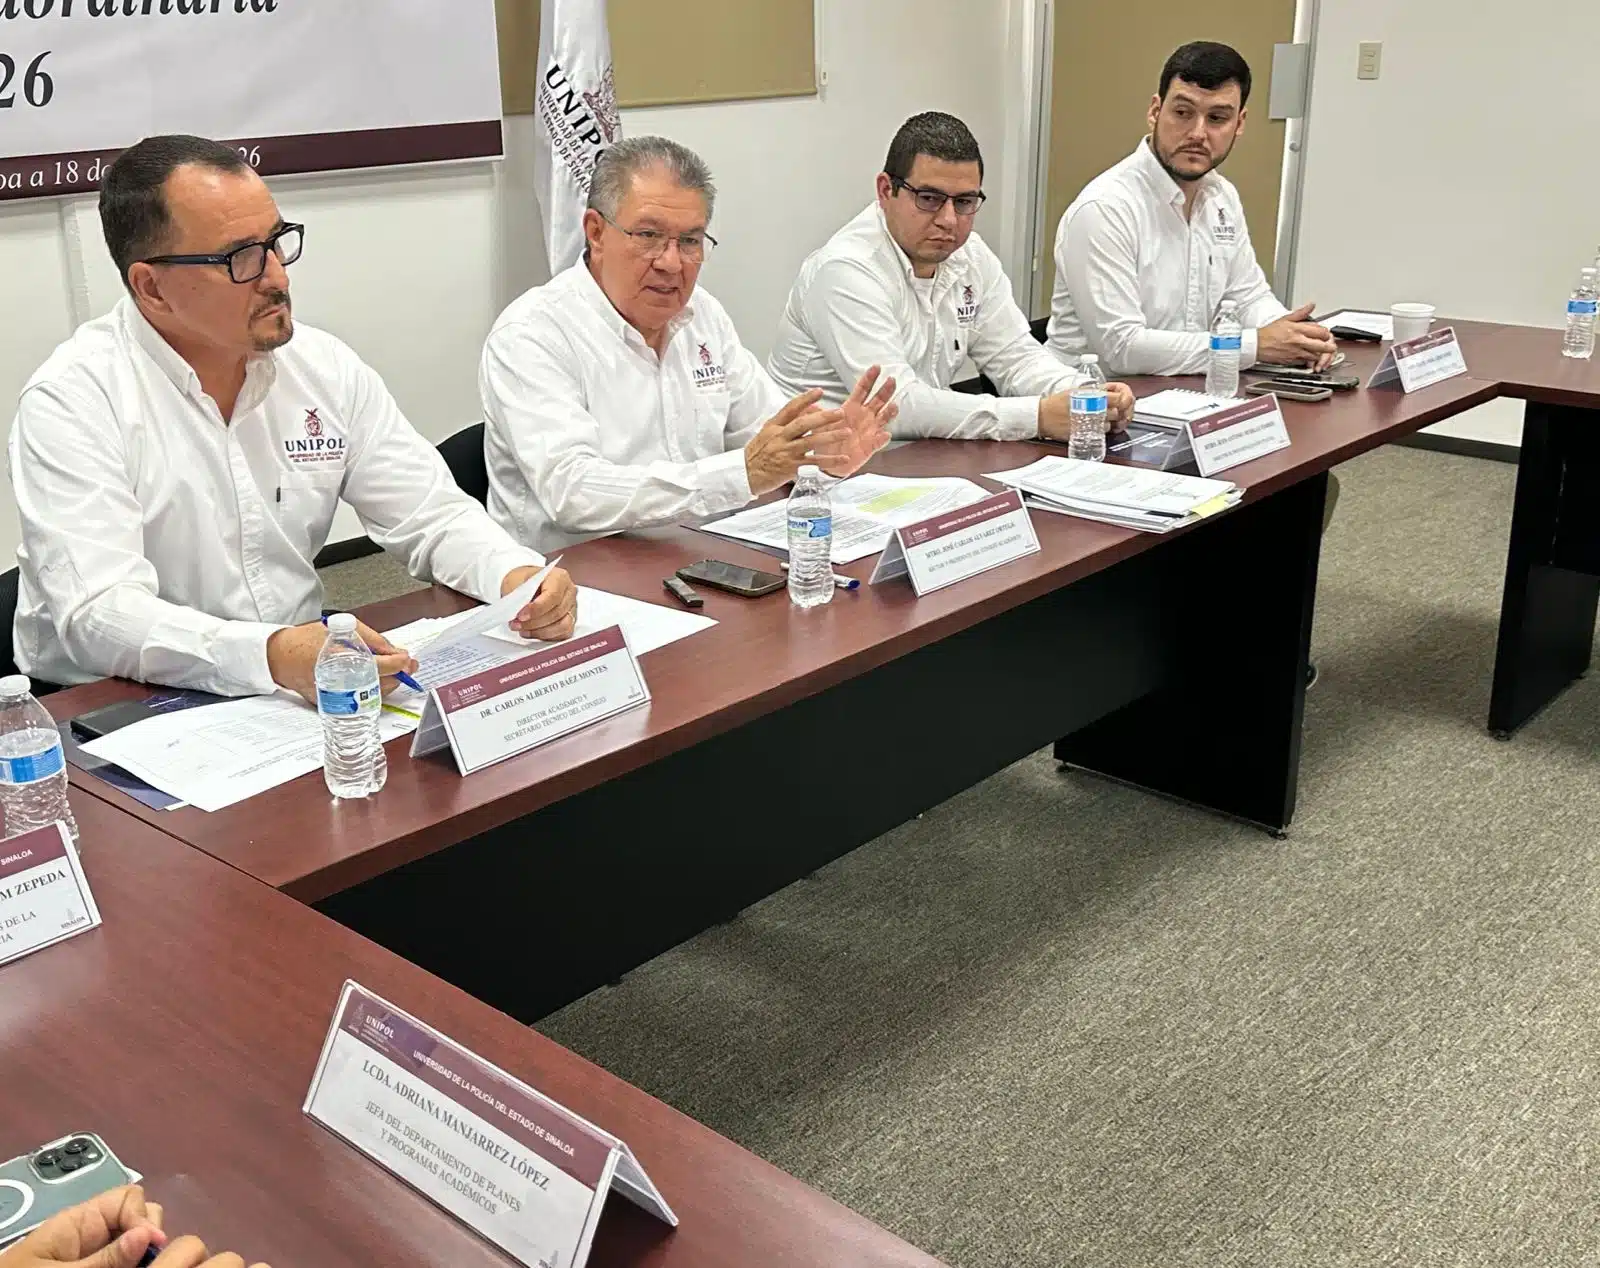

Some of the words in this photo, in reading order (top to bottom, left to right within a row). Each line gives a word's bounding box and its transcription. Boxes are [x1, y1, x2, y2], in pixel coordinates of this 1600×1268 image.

[540, 80, 572, 139] UNIVERSIDAD
[569, 138, 582, 151] DE
[543, 111, 563, 147] ESTADO
[559, 149, 572, 161] DE
[30, 170, 44, 187] a
[54, 160, 79, 185] 18
[284, 438, 346, 452] UNIPOL
[458, 684, 483, 696] UNIPOL
[495, 697, 525, 713] CARLOS
[525, 683, 559, 701] ALBERTO
[579, 664, 609, 681] MONTES
[504, 723, 542, 742] SECRETARIO
[568, 707, 582, 717] DEL
[516, 710, 547, 727] DIRECTOR
[0, 849, 33, 866] SINALOA
[14, 868, 67, 896] ZEPEDA
[5, 914, 21, 928] DE
[21, 910, 37, 922] LA
[365, 1015, 395, 1038] UNIPOL
[413, 1050, 453, 1079] UNIVERSIDAD
[452, 1073, 462, 1085] DE
[461, 1079, 470, 1091] LA
[470, 1085, 494, 1106] POLICÍA
[494, 1100, 508, 1115] DEL
[508, 1109, 535, 1131] ESTADO
[534, 1127, 545, 1138] DE
[545, 1132, 575, 1157] SINALOA
[362, 1059, 392, 1089] LCDA.
[392, 1081, 440, 1120] ADRIANA
[440, 1110, 510, 1164] MANJARREZ
[510, 1155, 551, 1191] LÓPEZ
[365, 1100, 385, 1121] JEFA
[384, 1113, 403, 1131] DEL
[402, 1125, 472, 1179] DEPARTAMENTO
[471, 1171, 486, 1188] DE
[485, 1180, 522, 1212] PLANES
[380, 1128, 389, 1140] Y
[387, 1133, 439, 1175] PROGRAMAS
[438, 1169, 498, 1215] ACADÉMICOS
